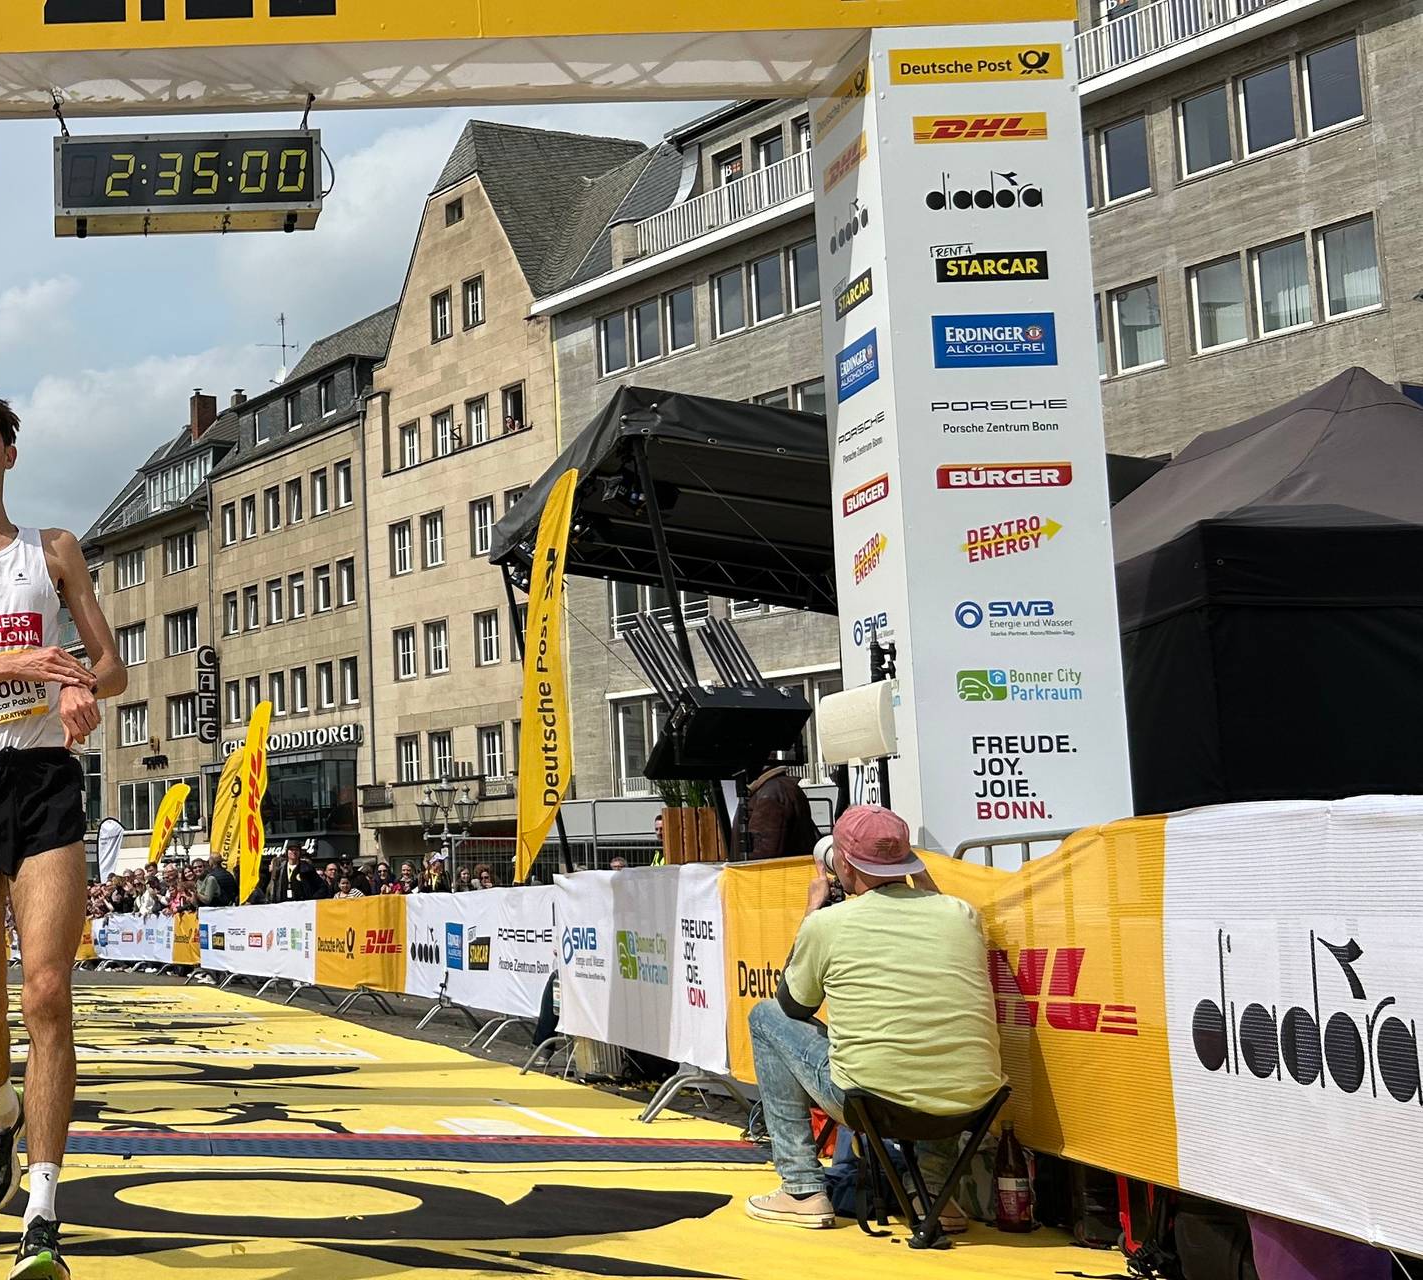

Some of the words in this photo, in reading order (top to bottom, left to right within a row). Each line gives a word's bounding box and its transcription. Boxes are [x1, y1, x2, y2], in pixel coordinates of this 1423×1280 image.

[901, 62, 973, 76] Deutsche
[977, 60, 1013, 72] Post
[932, 118, 1029, 139] DHL
[105, 149, 307, 197] 2:35:00
[926, 170, 1043, 210] diadora
[936, 246, 963, 257] RENT
[946, 258, 1039, 276] STARCAR
[839, 278, 869, 313] STARCAR
[945, 326, 1024, 342] ERDINGER
[946, 344, 1045, 353] ALKOHOLFREI
[840, 348, 867, 376] ERDINGER
[931, 399, 1067, 412] PORSCHE
[838, 411, 885, 446] PORSCHE
[943, 424, 983, 433] Porsche
[987, 423, 1029, 432] Zentrum
[1033, 422, 1059, 432] Bonn
[949, 467, 1059, 486] BÜRGER
[847, 481, 885, 512] BÜRGER
[967, 516, 1041, 545] DEXTRO
[854, 532, 879, 569] DEXTRO
[968, 532, 1041, 562] ENERGY
[855, 554, 881, 586] ENERGY
[989, 601, 1054, 617] SWB
[990, 620, 1021, 629] Energie
[1043, 619, 1073, 627] Wasser
[1010, 670, 1053, 682] Bonner
[1057, 668, 1081, 685] City
[1011, 684, 1082, 700] Parkraum
[13, 696, 36, 708] Pablo
[537, 681, 558, 806] Deutsche
[972, 735, 1077, 754] FREUDE.
[973, 758, 1023, 776] JOY.
[975, 779, 1037, 798] JOIE.
[977, 800, 1053, 820] BONN.
[498, 928, 552, 942] PORSCHE
[681, 918, 715, 940] FREUDE.
[365, 929, 397, 954] DHL
[572, 928, 597, 950] SWB
[514, 958, 536, 972] Zentrum
[638, 956, 669, 984] Parkraum
[1192, 928, 1423, 1107] diadora
